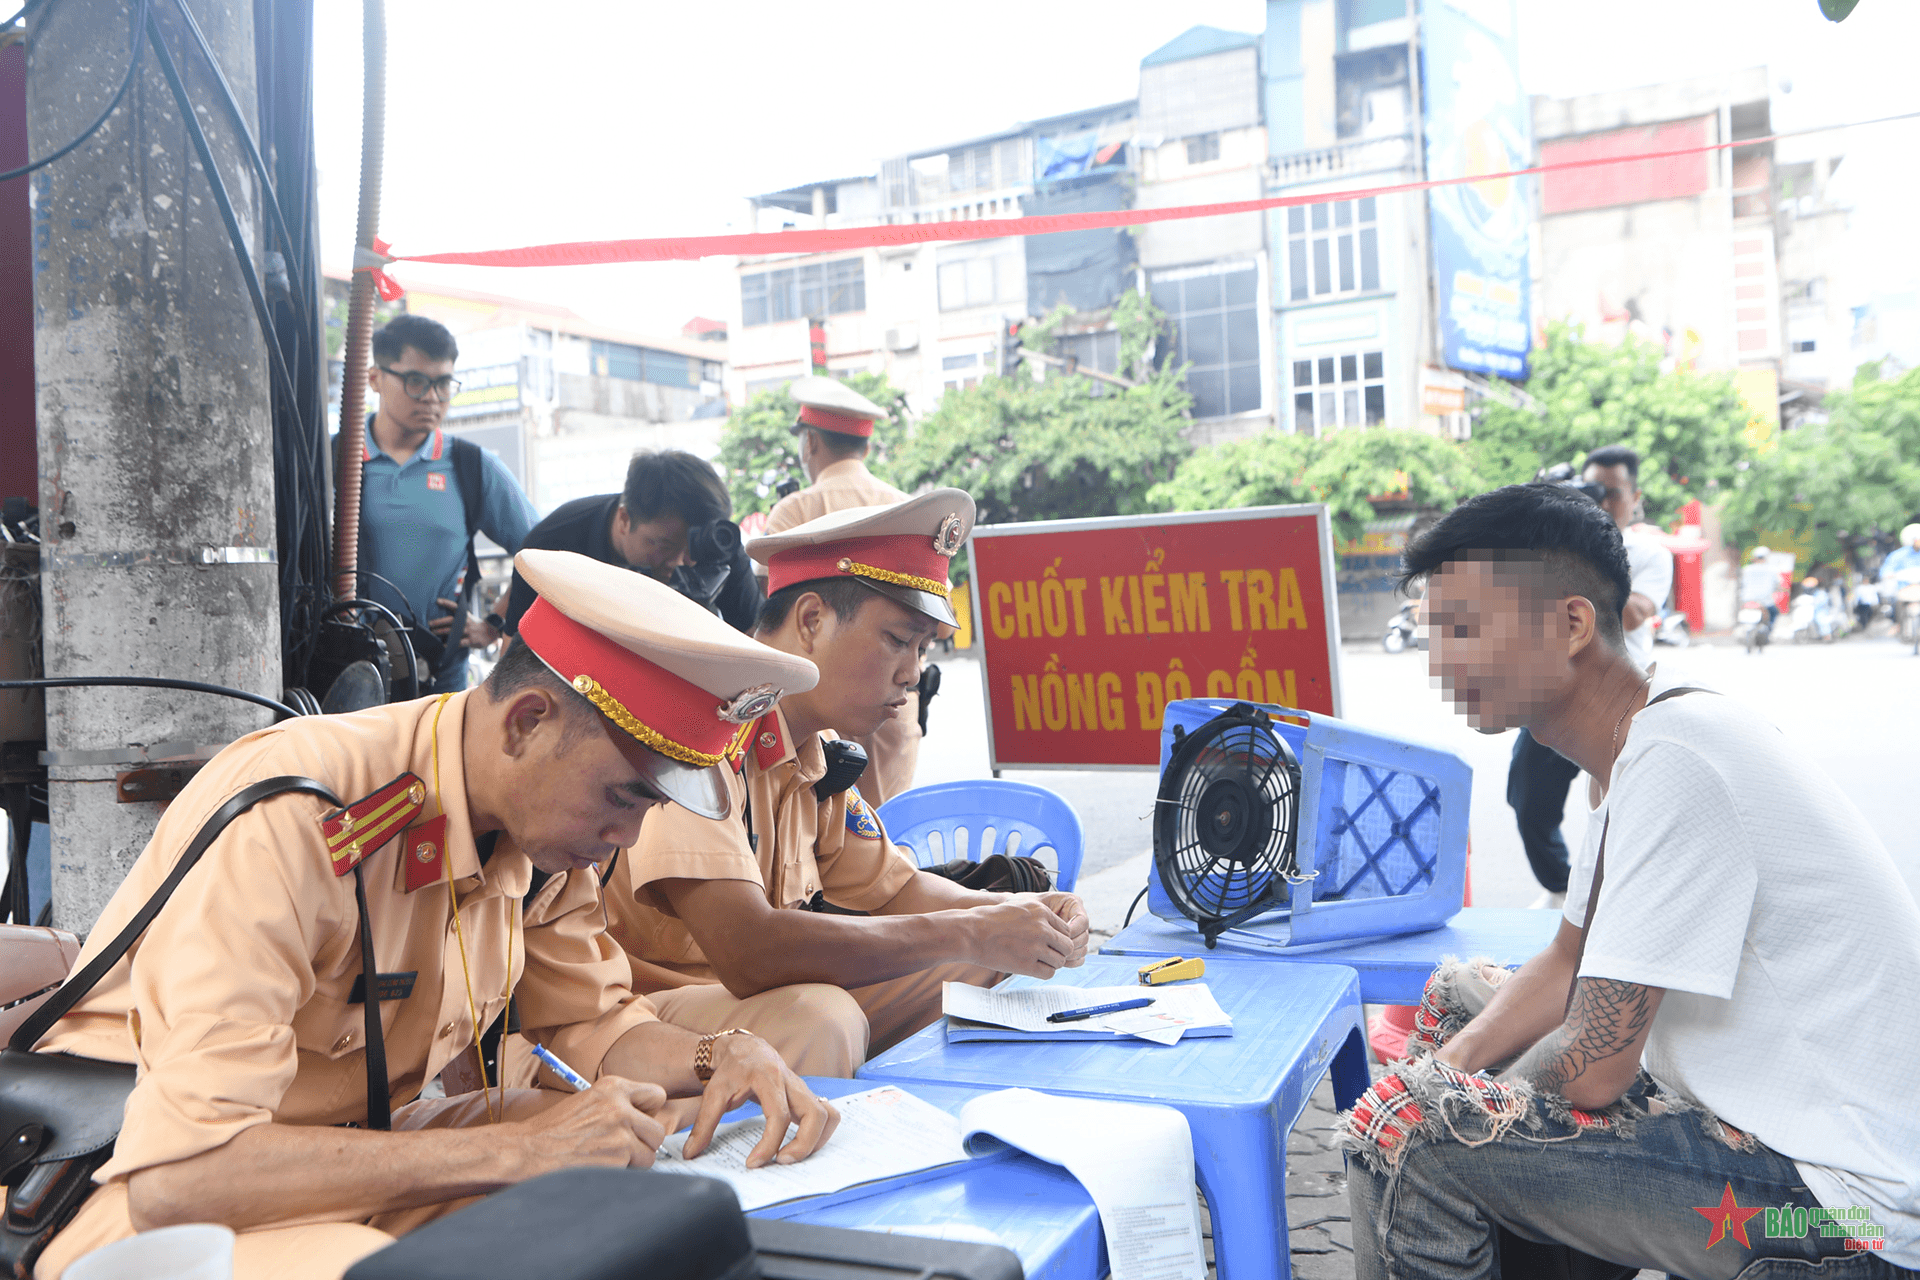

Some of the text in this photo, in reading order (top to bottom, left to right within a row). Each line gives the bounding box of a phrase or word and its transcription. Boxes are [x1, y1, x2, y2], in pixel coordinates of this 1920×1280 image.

[987, 547, 1308, 640] CHỐT KIỂM TRA
[1010, 652, 1126, 733] NỒNG
